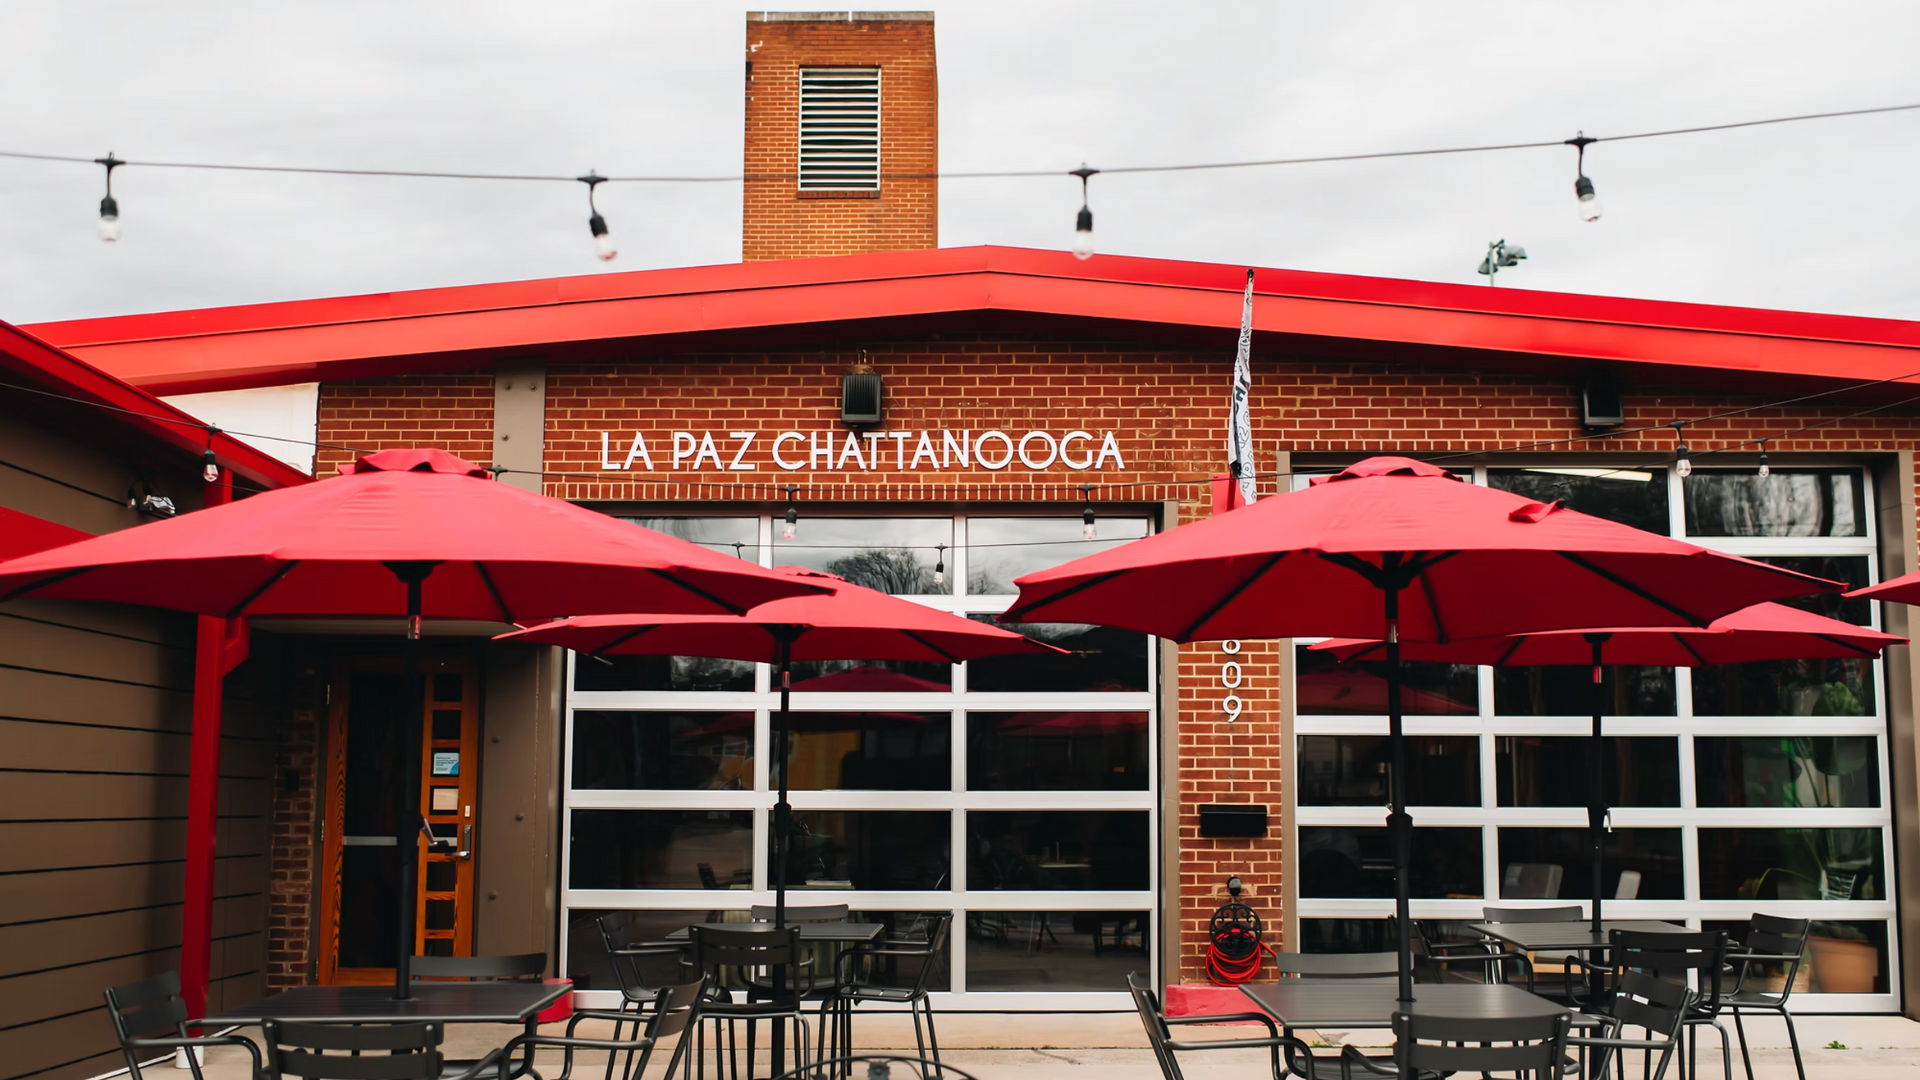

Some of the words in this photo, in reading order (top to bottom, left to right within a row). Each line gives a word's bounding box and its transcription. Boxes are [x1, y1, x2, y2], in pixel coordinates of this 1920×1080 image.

[601, 431, 653, 470] LA
[672, 431, 756, 470] PAZ
[771, 430, 1125, 470] CHATTANOOGA
